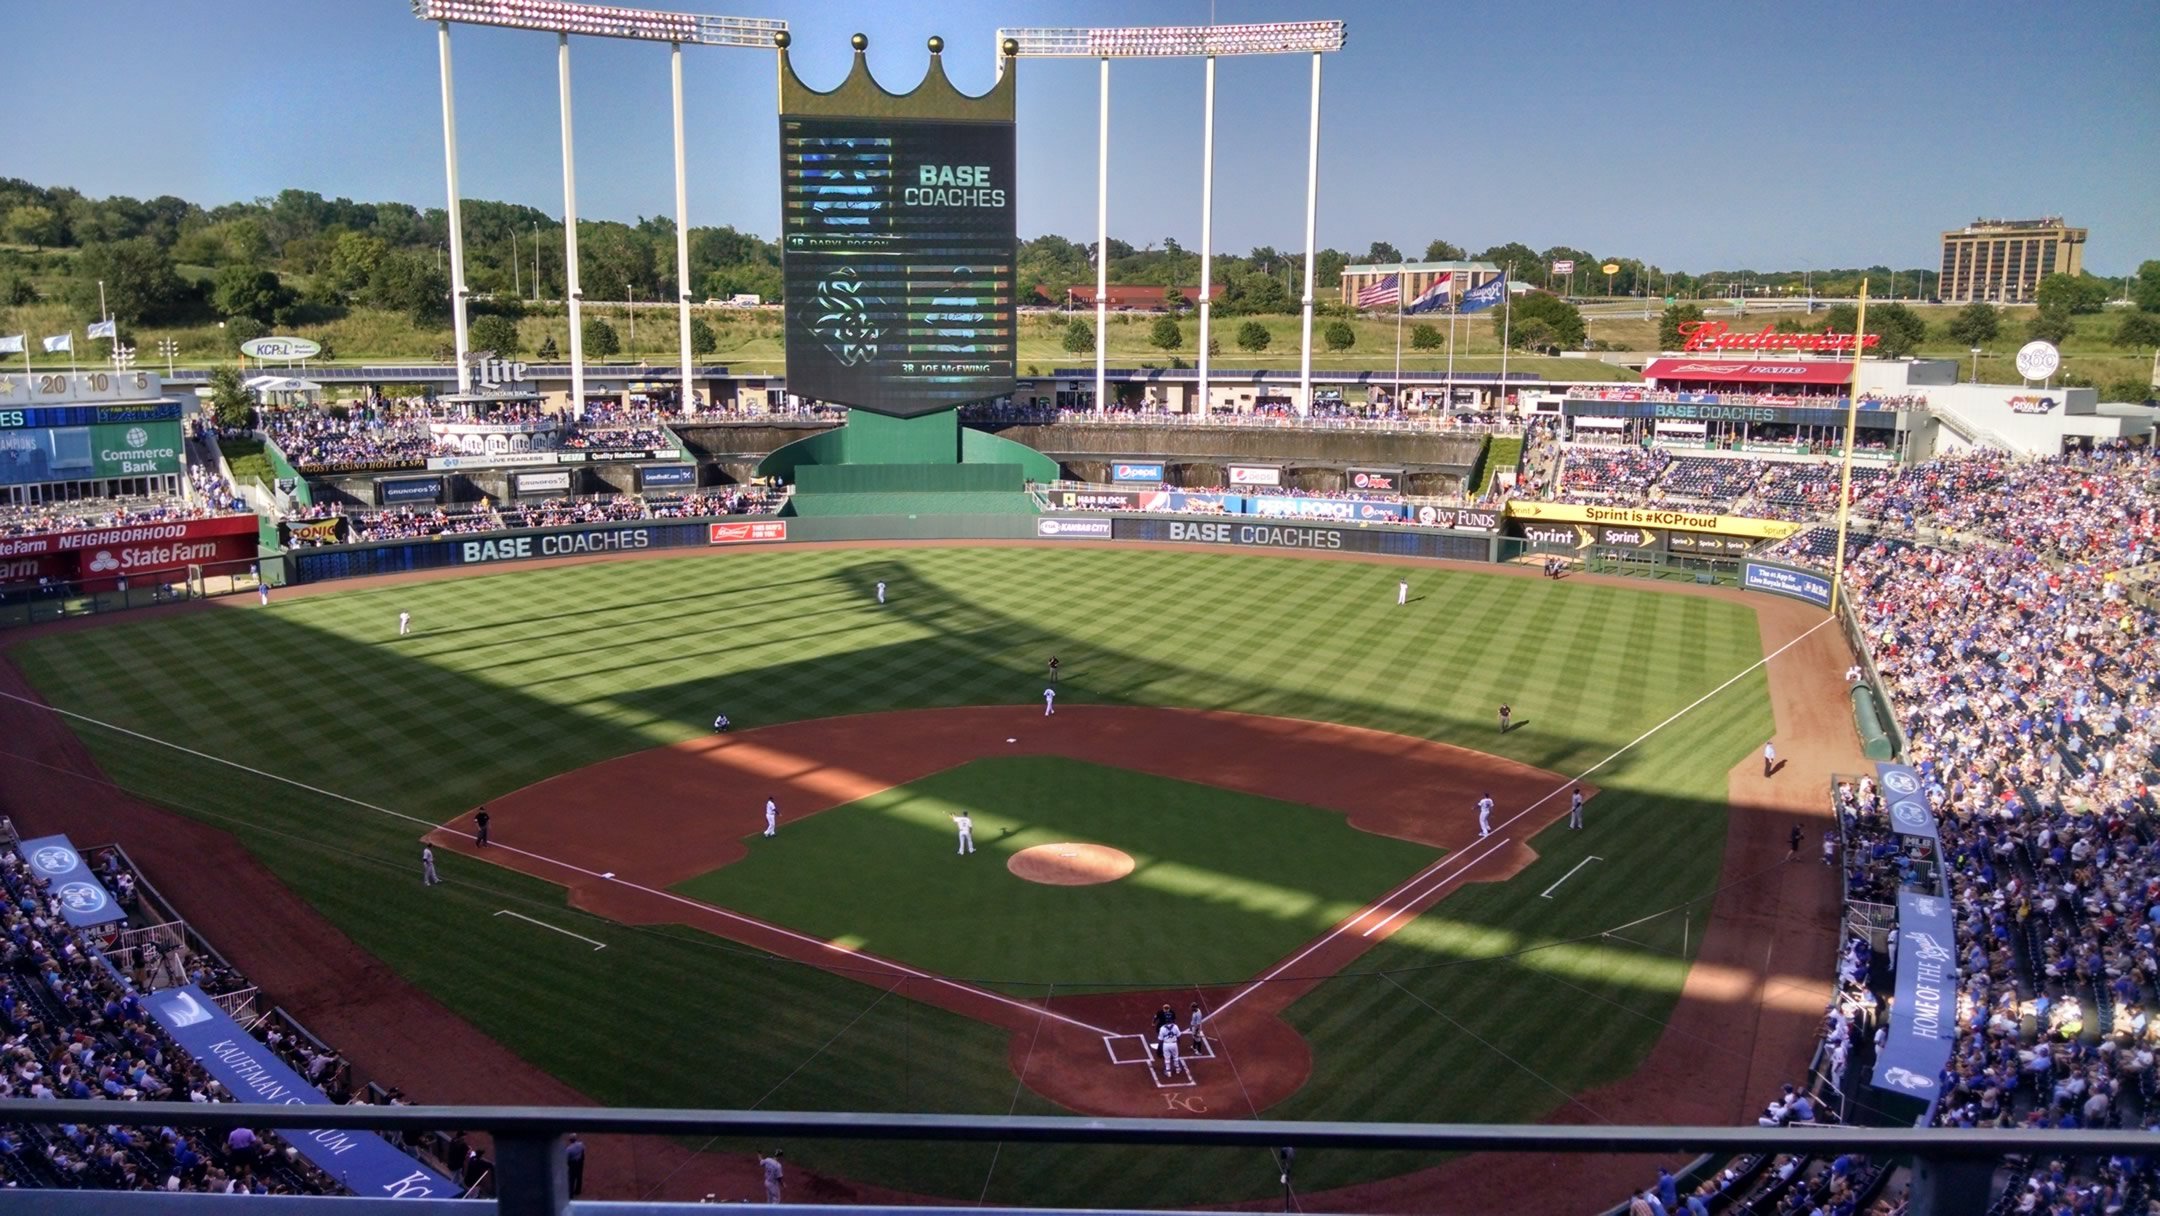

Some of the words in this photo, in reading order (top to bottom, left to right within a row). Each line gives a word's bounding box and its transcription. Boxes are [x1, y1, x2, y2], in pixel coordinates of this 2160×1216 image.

[919, 165, 991, 188] BASE
[904, 187, 1006, 208] COACHES
[1678, 320, 1881, 351] Budweiser
[256, 344, 291, 356] KCP&L
[920, 364, 939, 373] JOE
[941, 364, 991, 373] McEWING
[2020, 349, 2057, 373] 360
[478, 357, 528, 390] Lite
[40, 375, 67, 395] 20
[88, 373, 109, 392] 10
[136, 372, 148, 390] 5
[1655, 404, 1697, 418] BASE
[1699, 406, 1775, 421] COACHES
[2013, 402, 2049, 412] RIVALS
[0, 410, 25, 427] ES
[101, 447, 174, 462] Commerce
[591, 452, 614, 461] Quality
[614, 451, 646, 459] Healthcare
[122, 459, 158, 474] Bank
[332, 462, 367, 472] CASINO
[369, 461, 398, 470] HOTEL
[400, 460, 408, 468] &
[408, 459, 425, 468] SPA
[1130, 467, 1157, 478] pepsi
[1248, 472, 1274, 482] pepsi
[1077, 495, 1097, 504] H&R
[1097, 496, 1128, 505] BLOCK
[1301, 501, 1355, 518] PORCH
[1586, 507, 1629, 521] Sprint
[1632, 509, 1643, 522] is
[1645, 512, 1718, 529] #KCProud
[58, 524, 187, 549] NEIGHBORHOOD
[291, 523, 337, 539] SONIC
[1092, 523, 1109, 533] CITY
[1169, 522, 1232, 543] BASE
[1240, 525, 1342, 549] COACHES
[1605, 529, 1640, 544] Sprint
[1524, 526, 1574, 548] Sprint
[1671, 537, 1688, 545] Sprint
[1698, 539, 1716, 548] Sprint
[1726, 541, 1744, 549] Sprint
[463, 537, 533, 563] BASE
[541, 529, 649, 555] COACHES
[1905, 837, 1932, 847] MLB
[1904, 931, 1951, 962] Royals
[1917, 961, 1941, 984] THE
[1915, 983, 1940, 1001] OF
[1912, 1000, 1940, 1039] HOME
[208, 1039, 290, 1100] KAUFFMAN
[1160, 1091, 1208, 1113] KC
